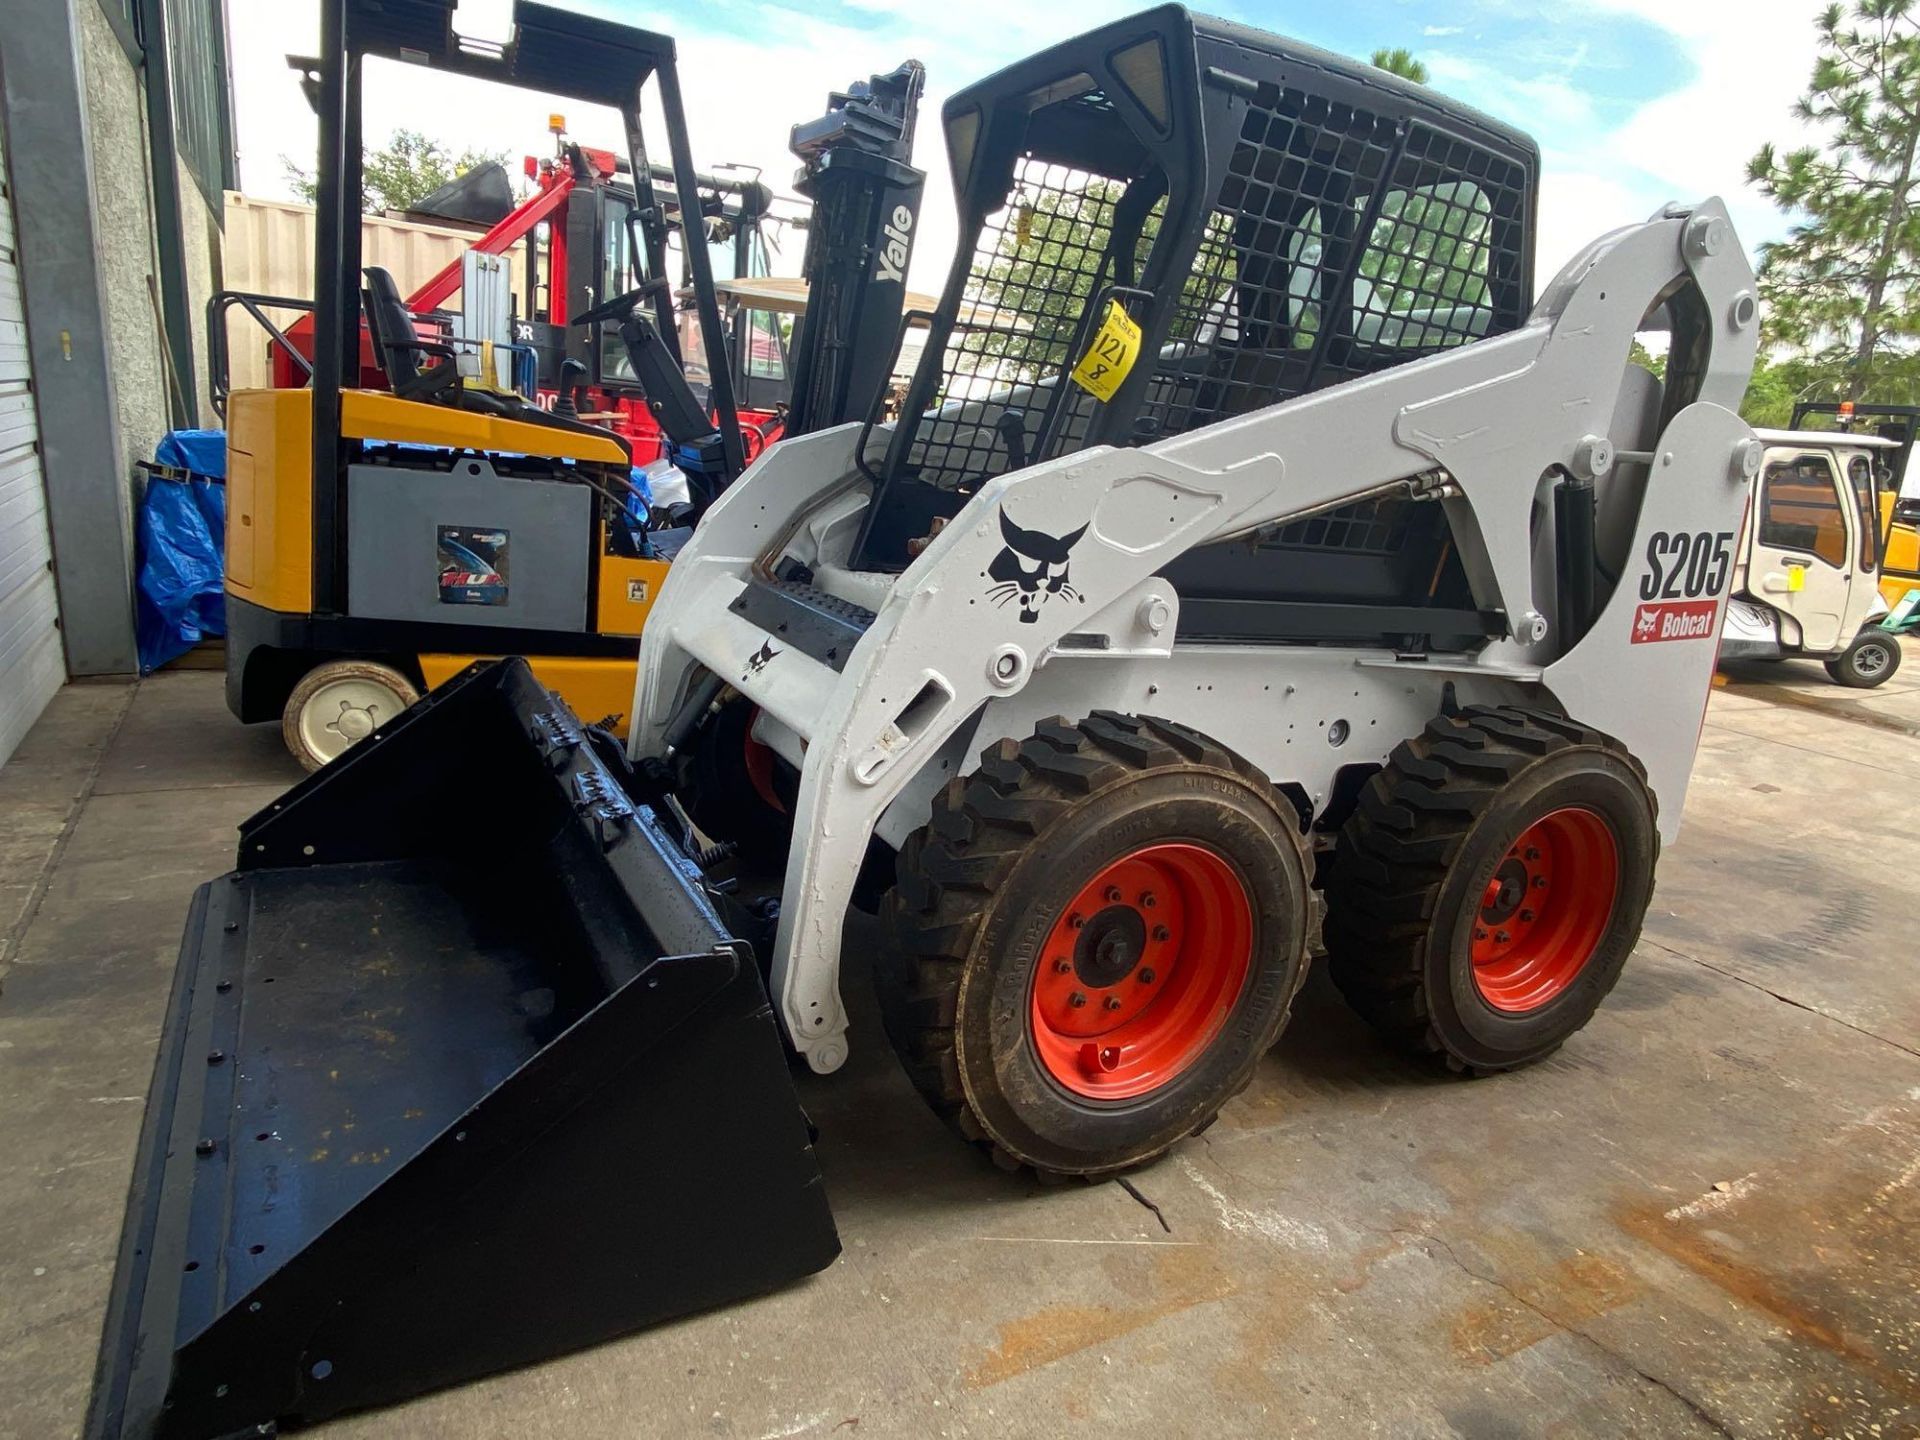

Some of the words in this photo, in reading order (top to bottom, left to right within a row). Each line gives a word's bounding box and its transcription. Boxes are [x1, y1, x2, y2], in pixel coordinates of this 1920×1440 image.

[876, 205, 913, 283] Yale
[1095, 333, 1127, 366] 121
[1089, 363, 1109, 380] 8
[1639, 531, 1734, 601] S205
[1661, 610, 1712, 639] Bobcat
